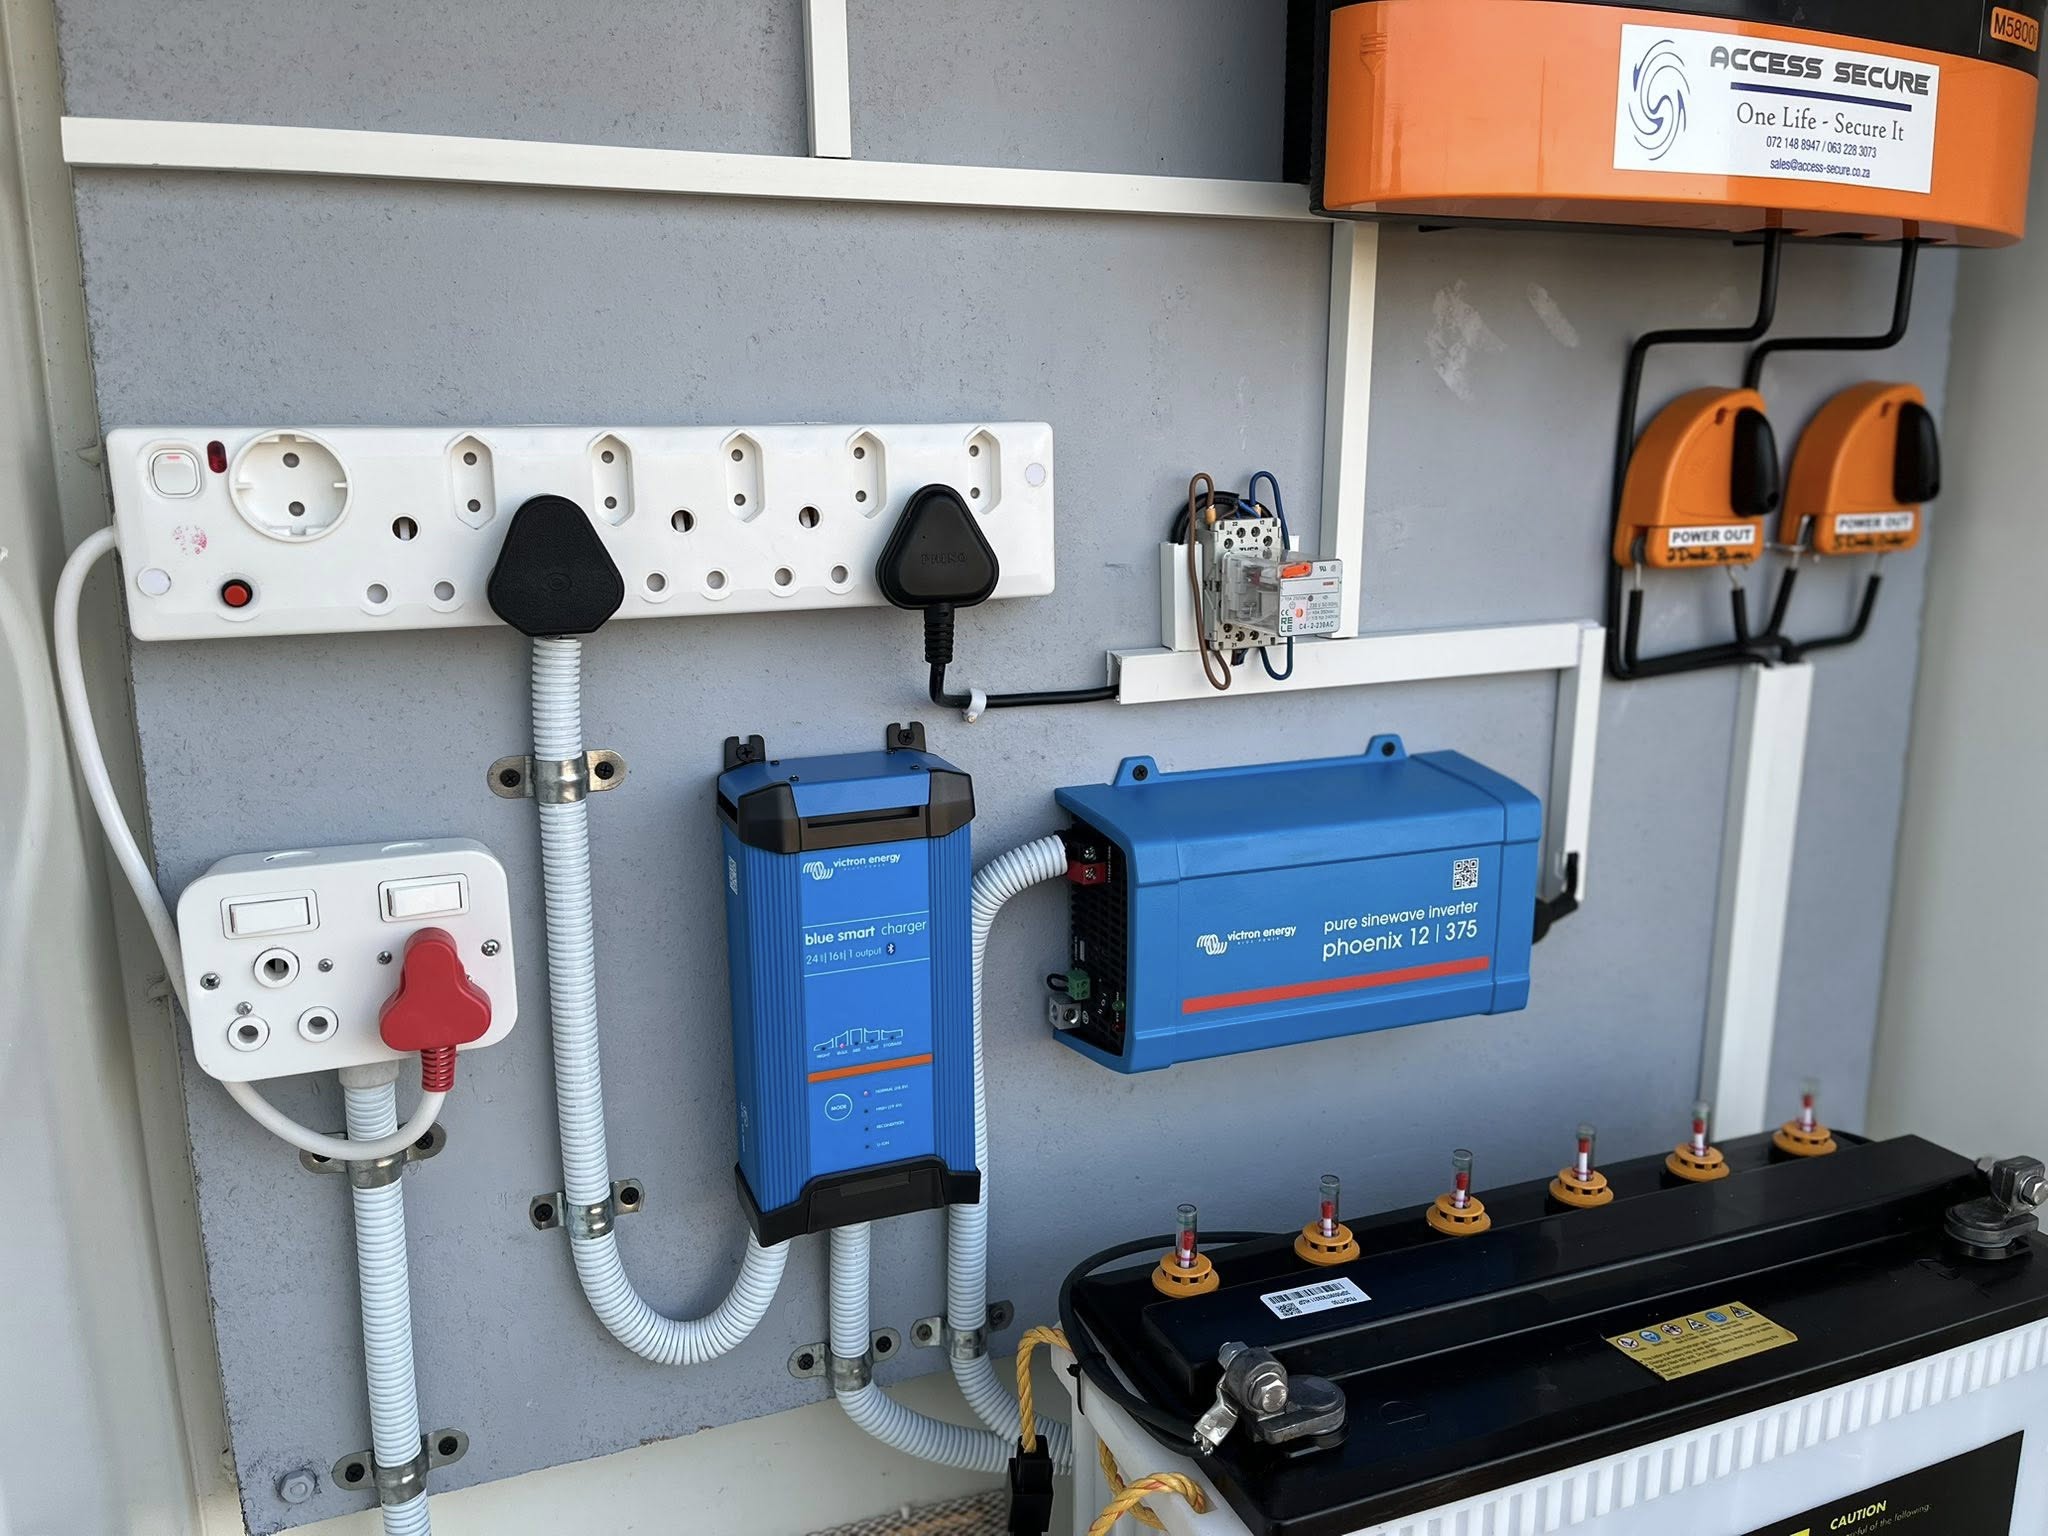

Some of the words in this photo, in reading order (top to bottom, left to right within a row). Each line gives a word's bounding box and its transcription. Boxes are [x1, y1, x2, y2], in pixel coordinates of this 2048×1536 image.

[1710, 46, 1824, 80] ACCESS
[1833, 61, 1931, 96] SECURE
[1737, 102, 1776, 126] One
[1783, 106, 1817, 130] Life
[1834, 112, 1887, 139] Secure
[1892, 120, 1905, 142] It
[1766, 136, 1782, 149] 072
[1784, 137, 1799, 150] 148
[1800, 138, 1821, 152] 8947
[1827, 142, 1842, 155] 063
[1843, 143, 1858, 156] 228
[1858, 145, 1877, 159] 3073
[1770, 157, 1871, 179] sales@access-secure.co.za
[1839, 517, 1881, 529] POWER
[1884, 515, 1910, 527] OUT
[1672, 531, 1720, 543] POWER
[1723, 528, 1752, 541] OUT
[1281, 616, 1293, 624] RE
[1281, 625, 1293, 633] LE
[833, 857, 866, 867] victron
[868, 853, 901, 864] energy
[1324, 917, 1358, 936] pure
[1361, 907, 1425, 929] sinewave
[1428, 900, 1479, 919] inverter
[805, 932, 834, 946] blue
[838, 925, 876, 942] smart
[881, 920, 927, 936] charger
[1227, 930, 1261, 942] victron
[1262, 925, 1297, 937] energy
[1322, 931, 1403, 963] phoenix
[1410, 925, 1430, 946] 12
[1444, 919, 1478, 941] 375
[855, 947, 882, 957] output
[830, 1104, 847, 1112] MODE
[876, 1120, 905, 1129] RECONDITION
[1829, 1499, 1888, 1531] CAUTION
